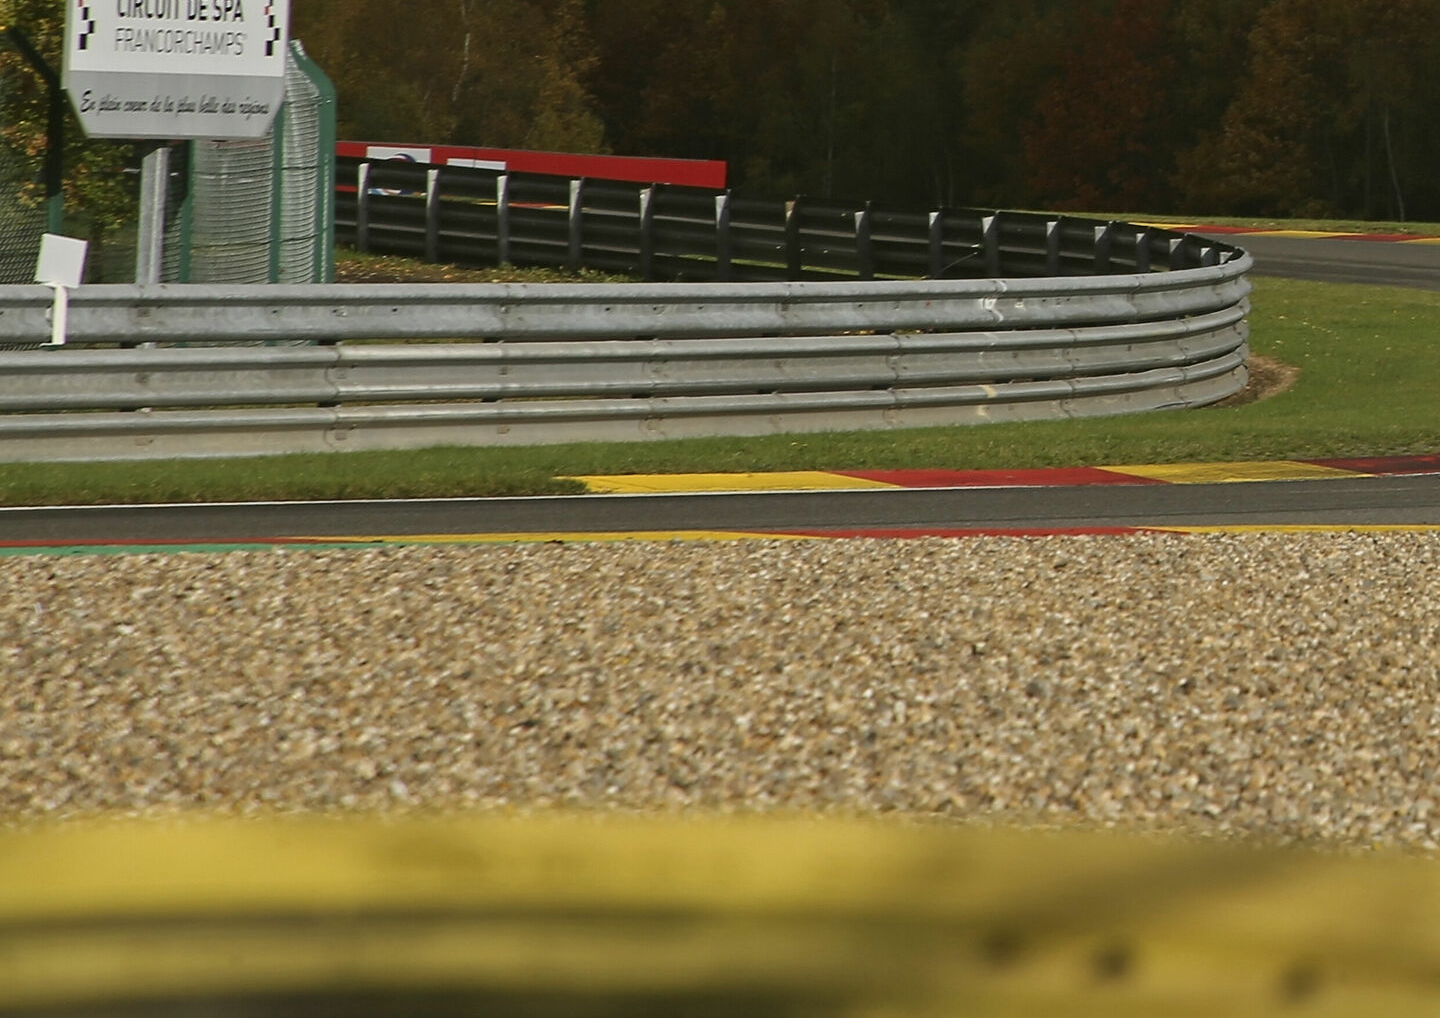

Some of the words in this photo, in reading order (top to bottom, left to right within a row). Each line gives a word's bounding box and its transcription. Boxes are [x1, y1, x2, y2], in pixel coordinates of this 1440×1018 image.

[114, 27, 246, 56] FRANCORCHAMPS
[80, 89, 97, 113] En
[150, 94, 163, 113] de
[163, 95, 175, 113] la
